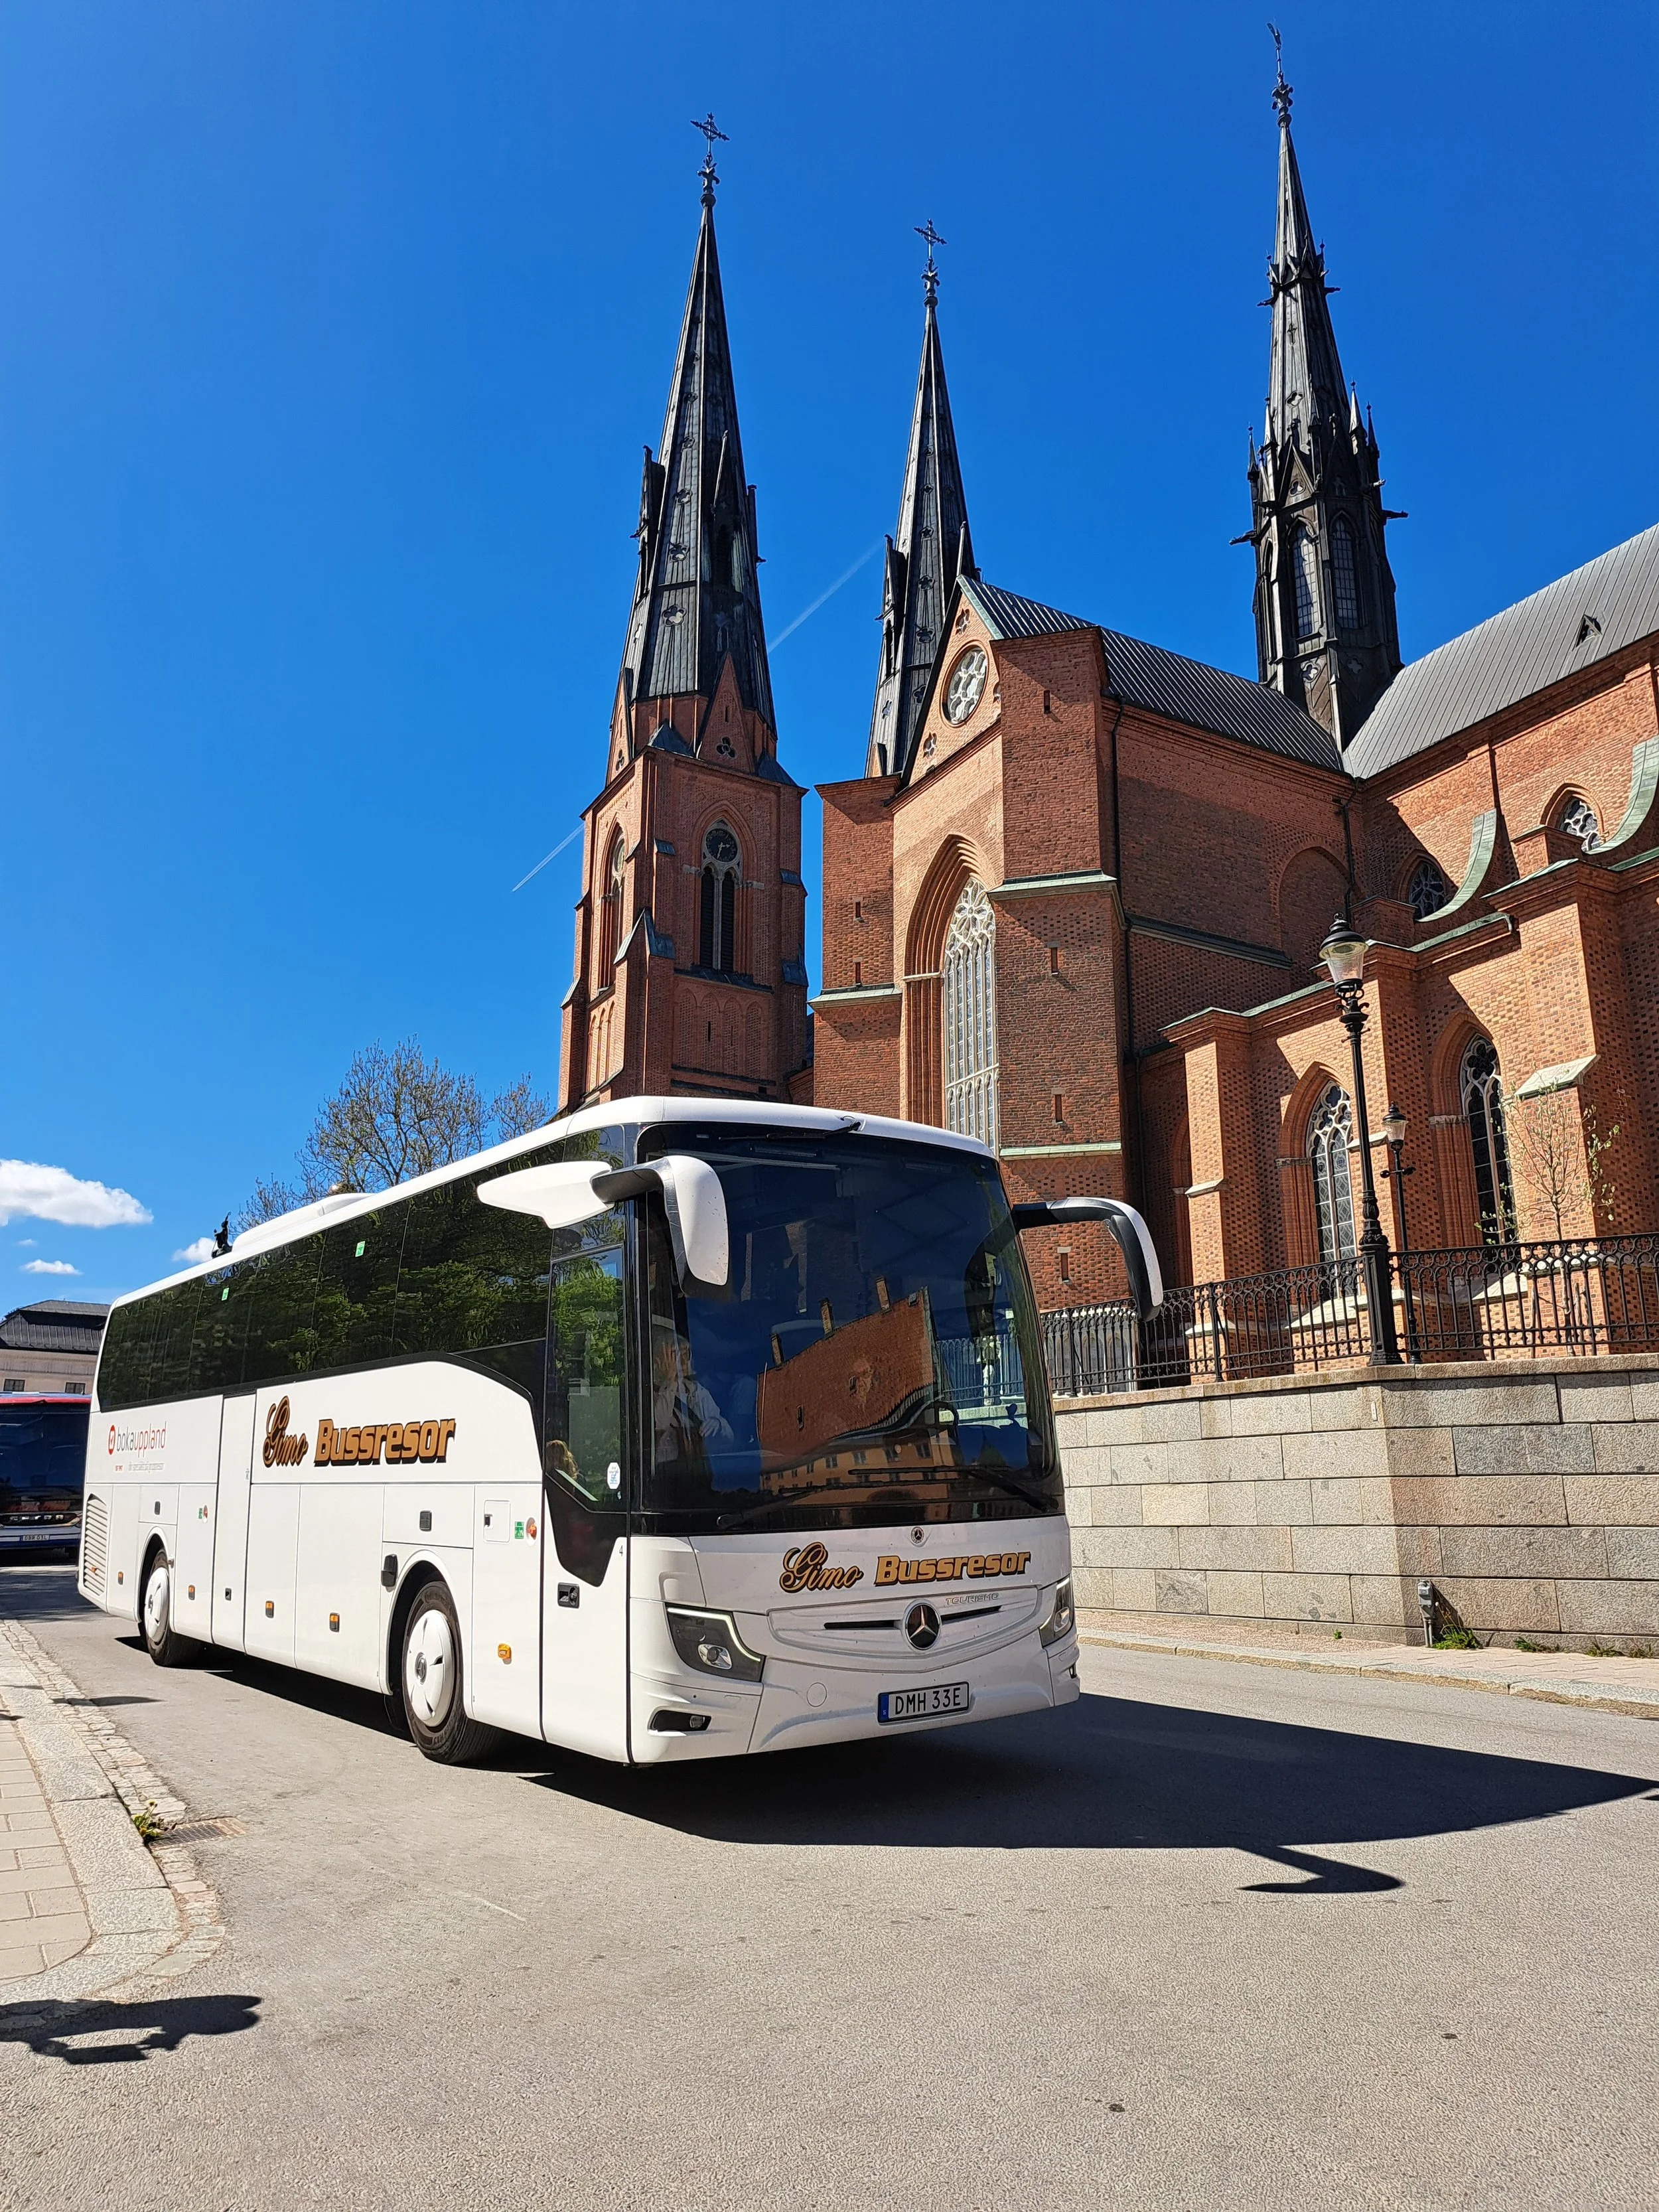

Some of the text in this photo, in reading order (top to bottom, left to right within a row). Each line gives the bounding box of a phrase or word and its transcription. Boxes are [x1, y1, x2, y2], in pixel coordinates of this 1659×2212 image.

[117, 1421, 167, 1458] bokauppland
[263, 1395, 456, 1467] Gimo Bussresor
[619, 1545, 623, 1556] 4
[779, 1542, 1031, 1593] Gimo Bussresor
[946, 1593, 999, 1605] TOURISMO
[895, 1687, 961, 1715] DMH 33E
